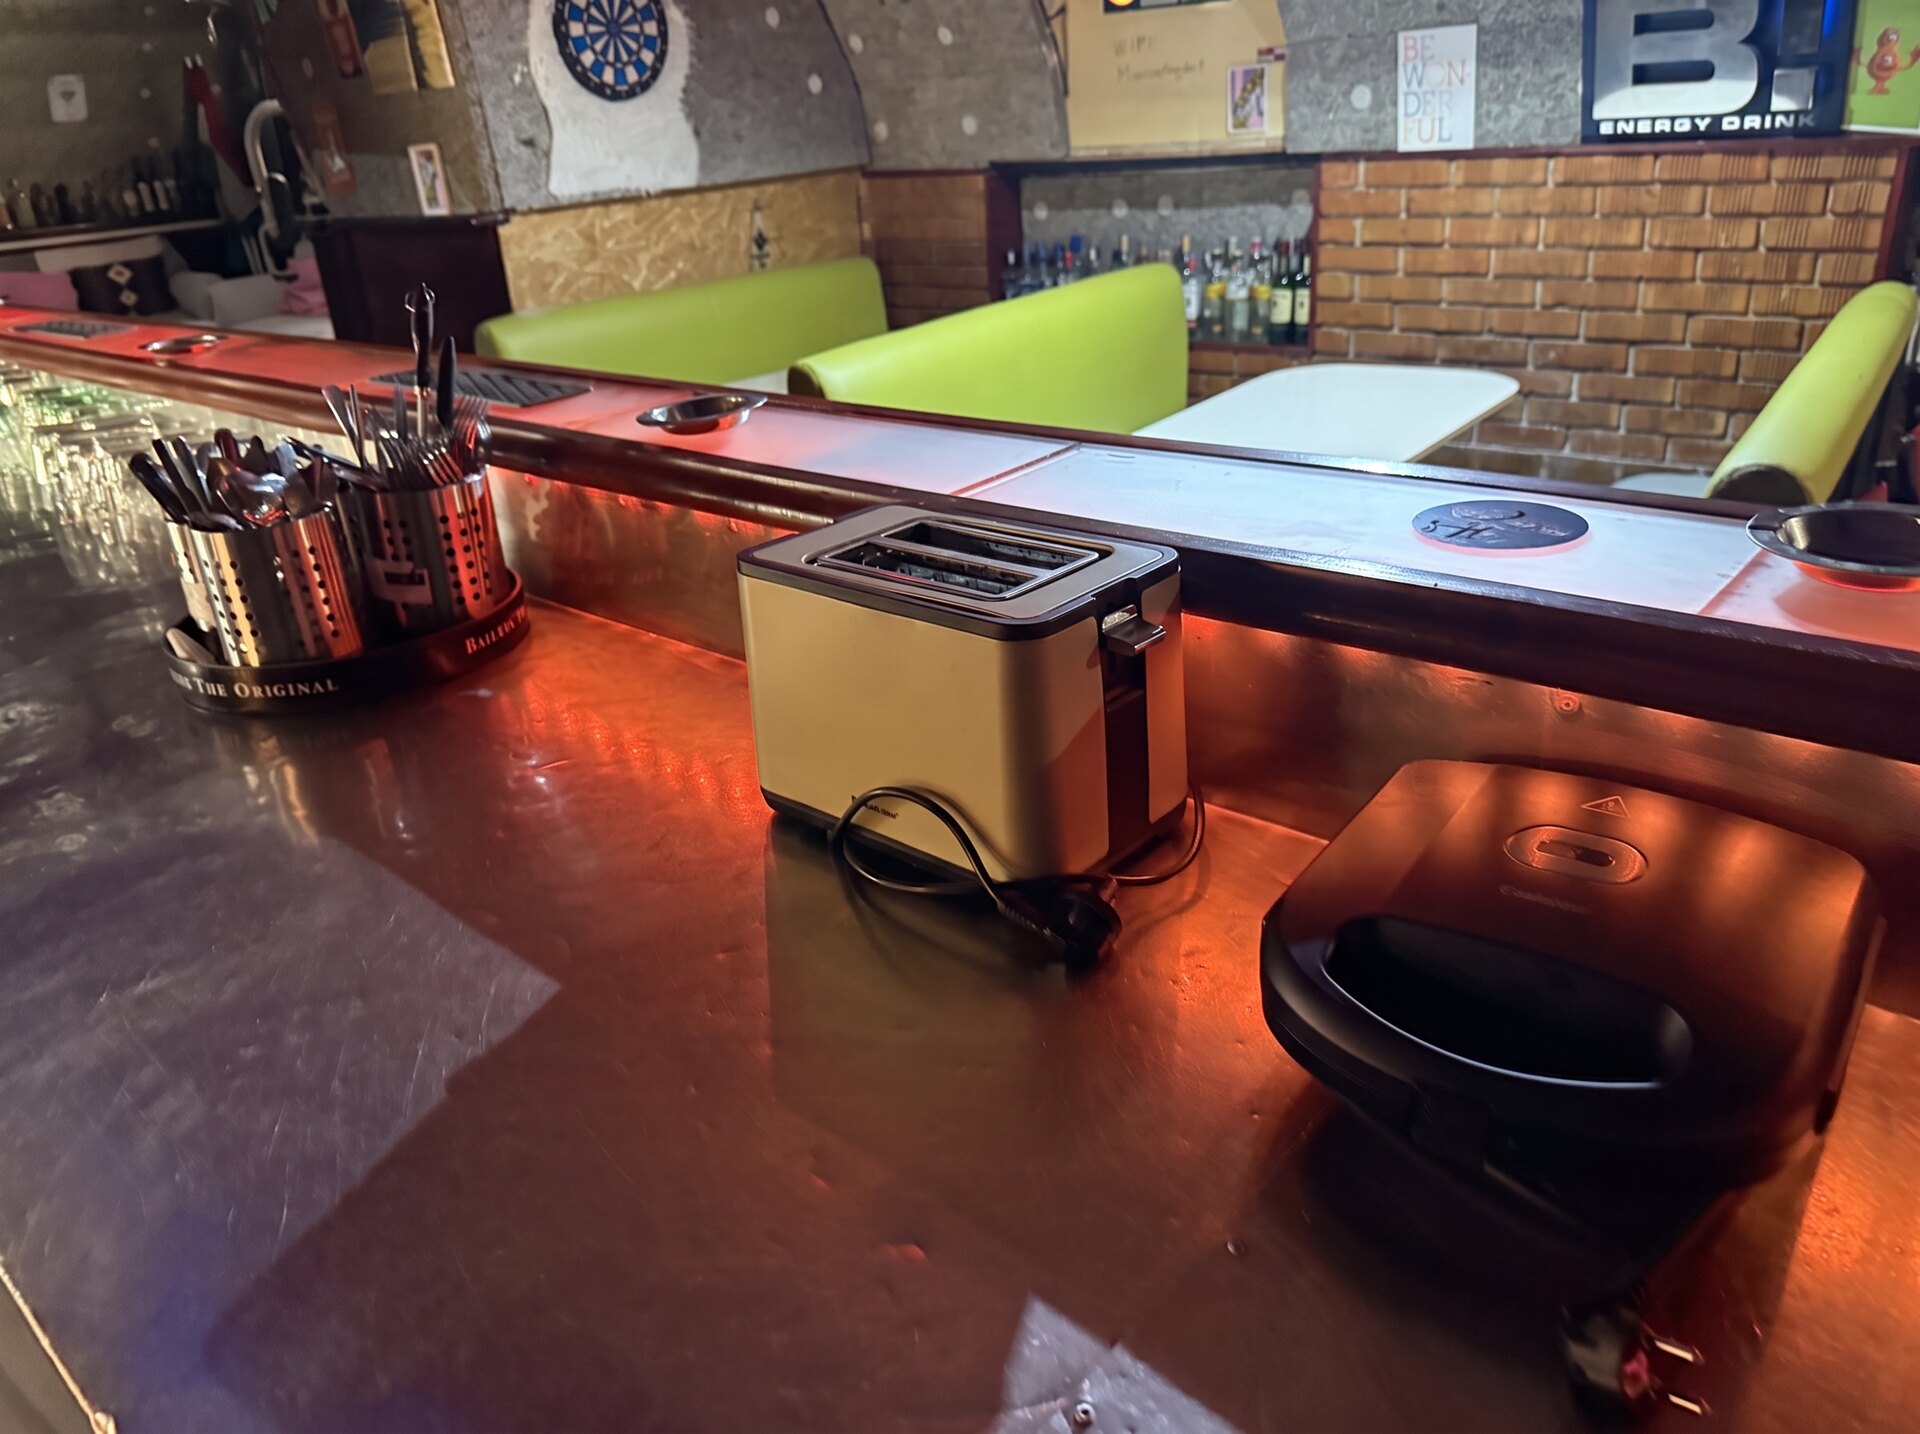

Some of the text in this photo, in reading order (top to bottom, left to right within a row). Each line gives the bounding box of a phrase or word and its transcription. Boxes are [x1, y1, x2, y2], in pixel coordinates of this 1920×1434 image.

[1402, 34, 1435, 63] BE
[1403, 89, 1453, 118] DER
[1403, 115, 1453, 145] FUL
[1599, 113, 1815, 136] ENERGY DRINK
[233, 678, 338, 699] ORIGINAL
